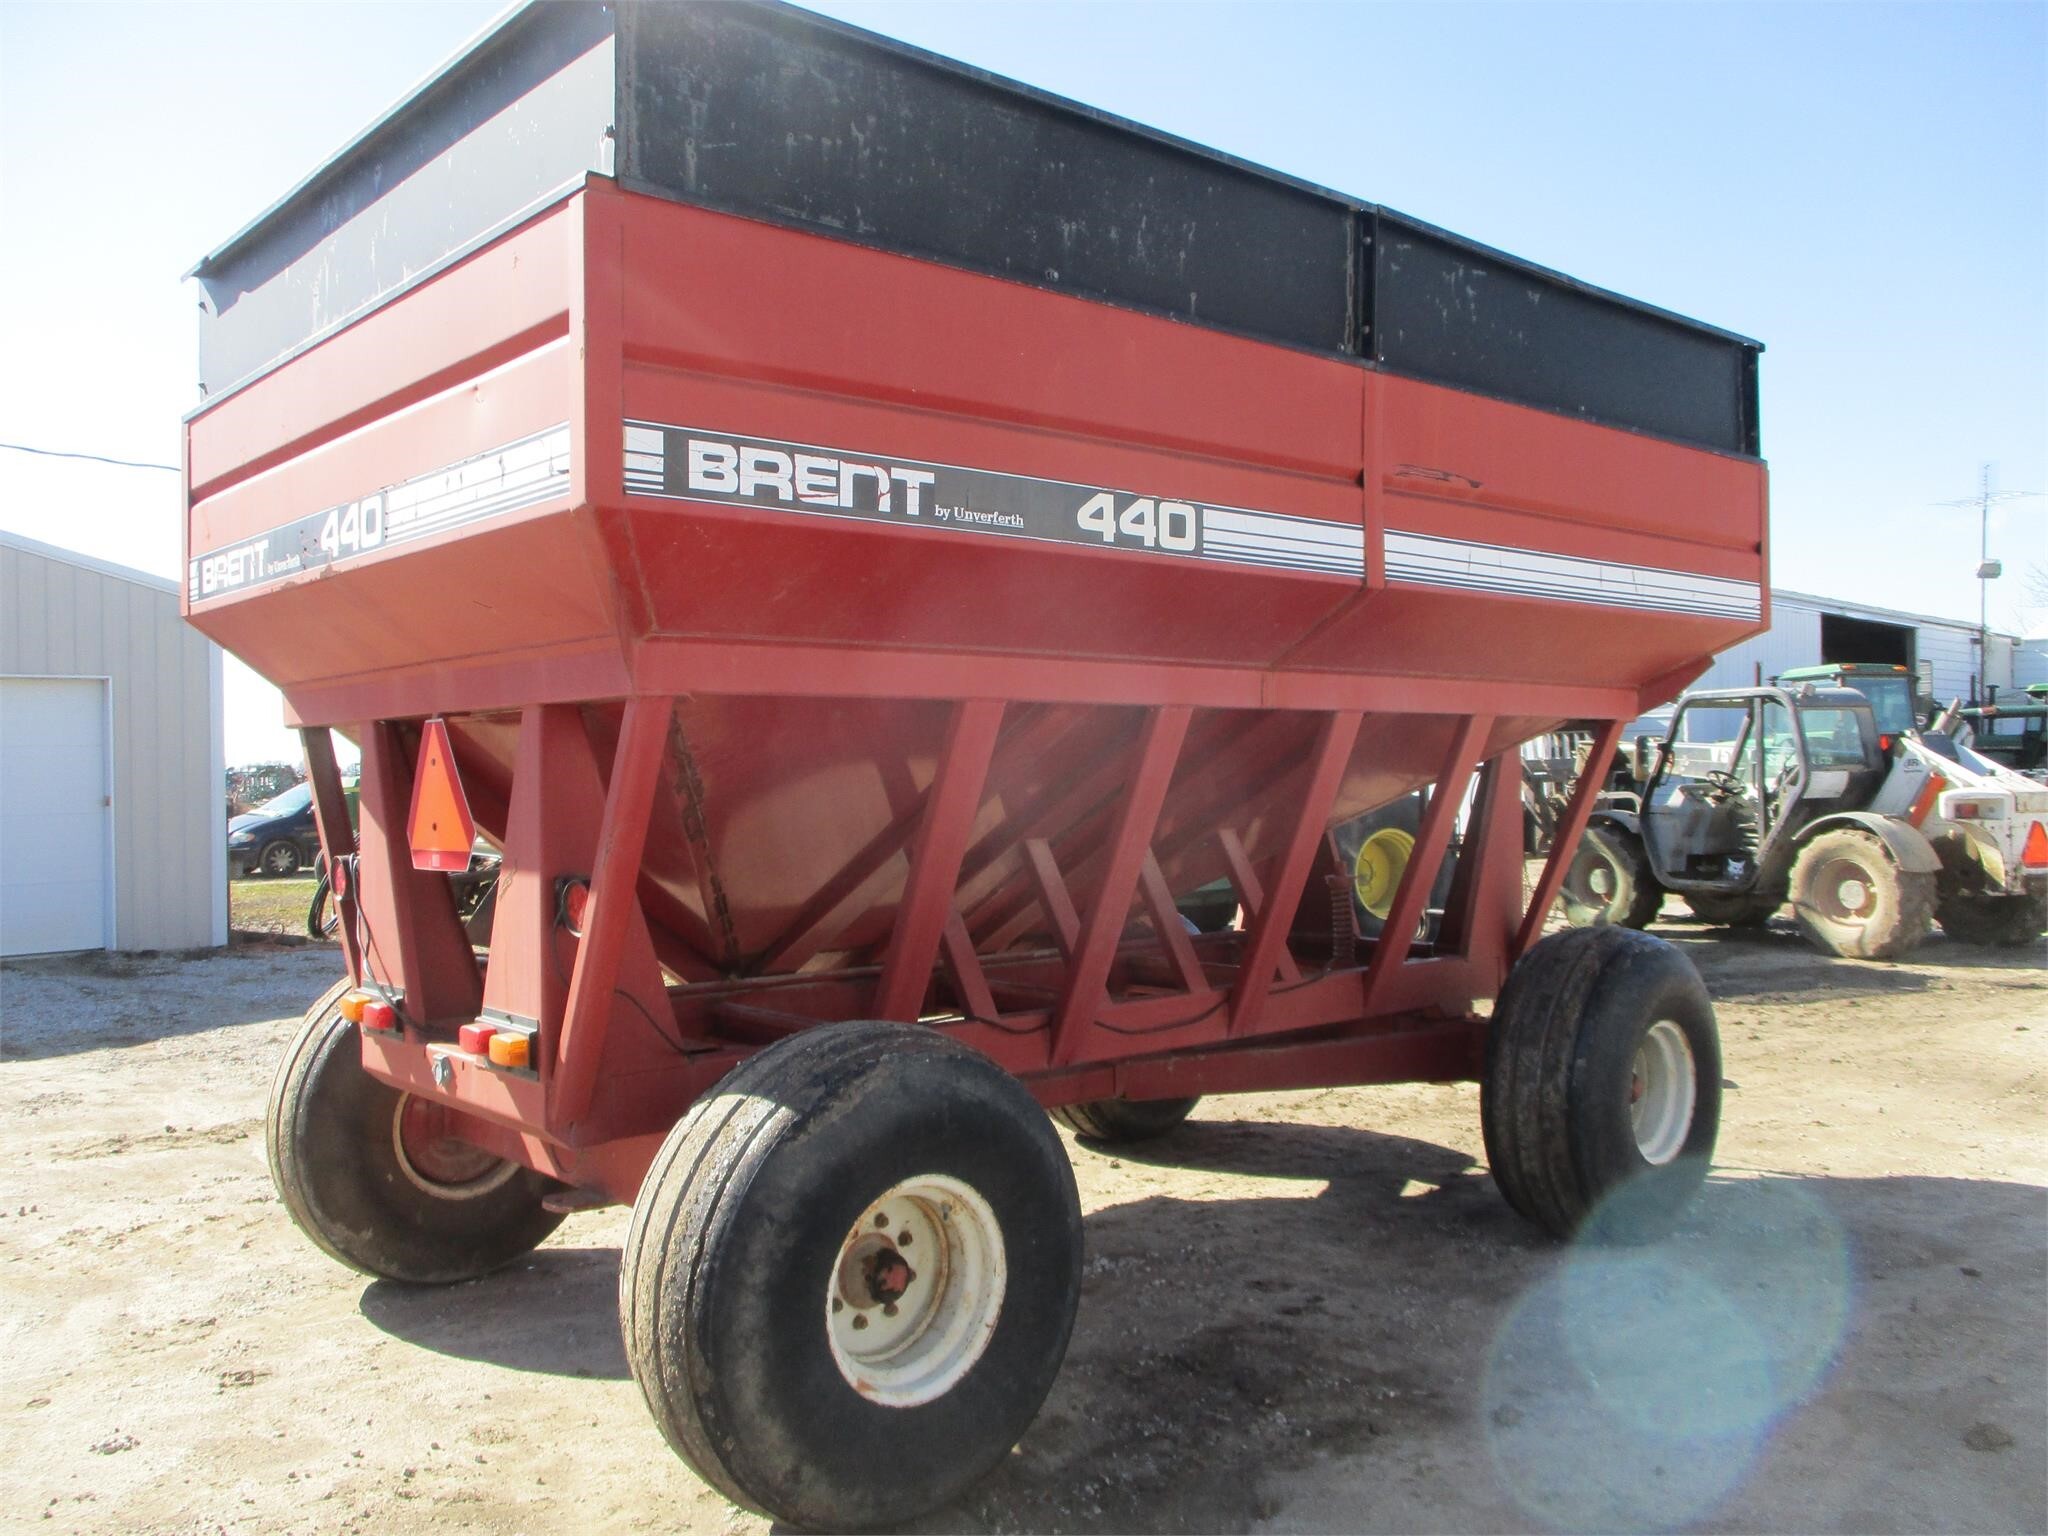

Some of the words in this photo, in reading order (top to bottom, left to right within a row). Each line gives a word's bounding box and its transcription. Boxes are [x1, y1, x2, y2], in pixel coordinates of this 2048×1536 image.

[202, 538, 270, 595] BRENT
[320, 494, 383, 558] 440
[687, 438, 936, 517] BRENT
[934, 504, 951, 521] by
[954, 506, 1025, 529] Unverferth
[1076, 492, 1196, 552] 440
